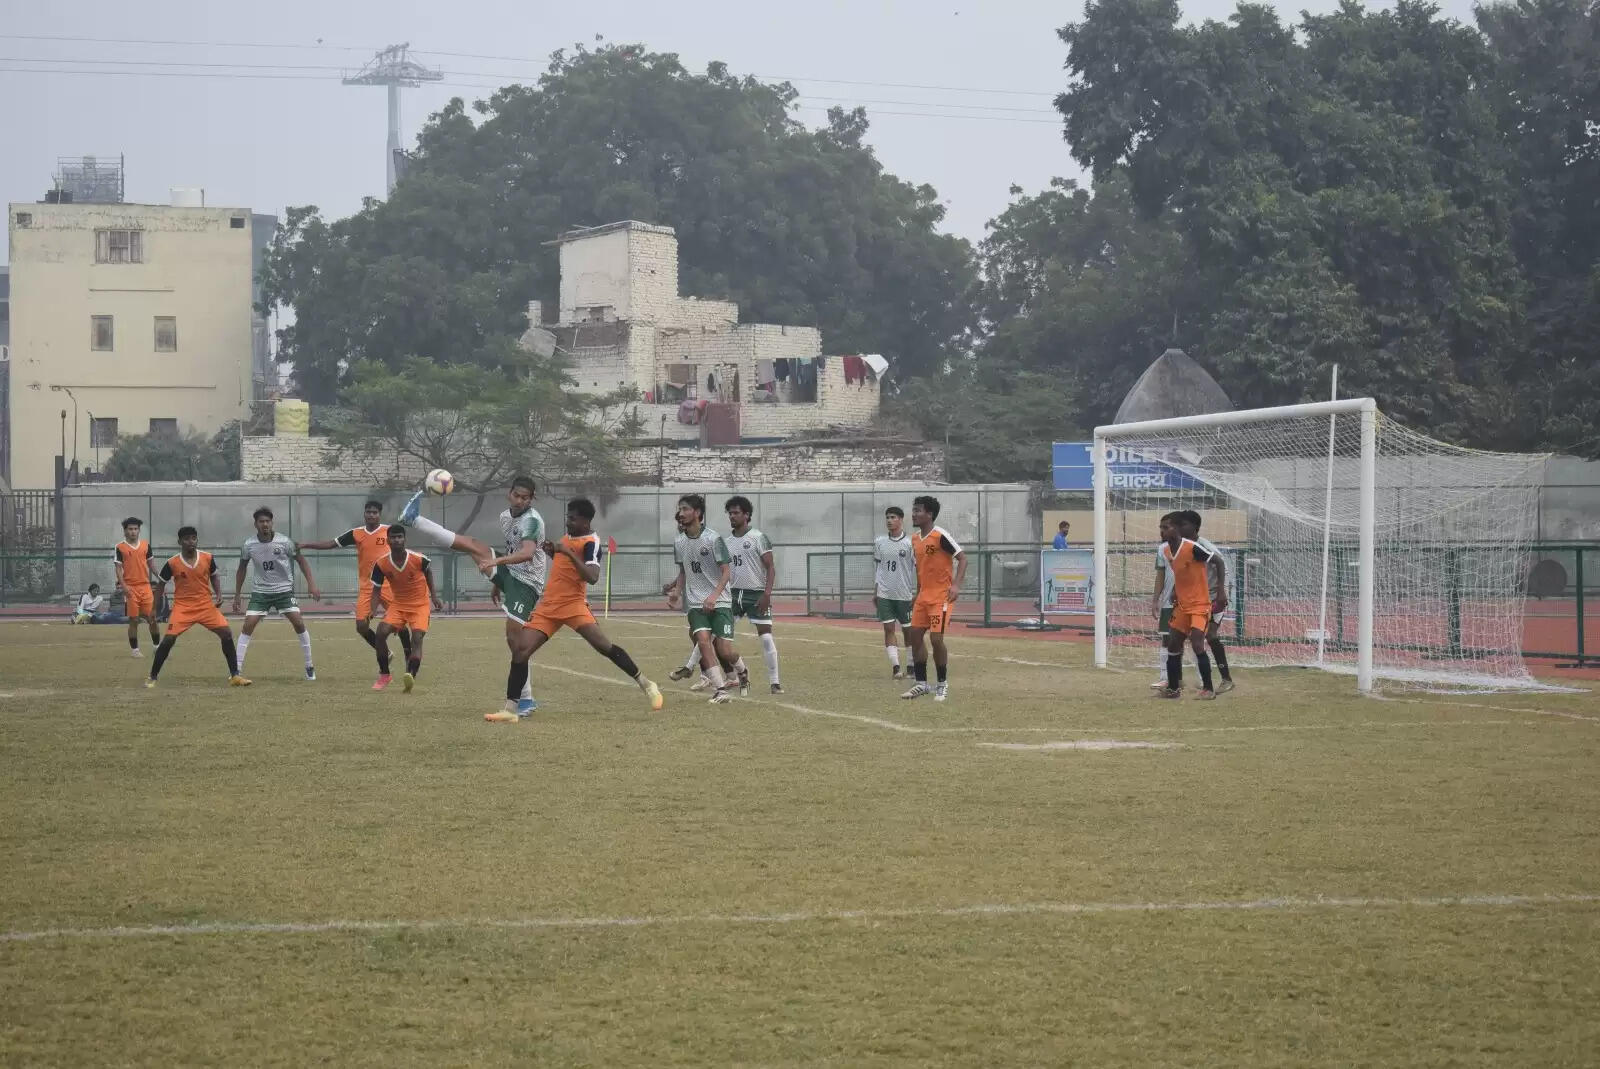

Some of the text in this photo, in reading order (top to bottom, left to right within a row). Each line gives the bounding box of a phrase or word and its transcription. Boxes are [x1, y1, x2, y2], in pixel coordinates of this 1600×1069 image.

[1084, 446, 1172, 463] TOILET
[375, 537, 385, 546] 23
[925, 545, 935, 555] 25
[886, 560, 897, 572] 18
[513, 601, 525, 614] 16
